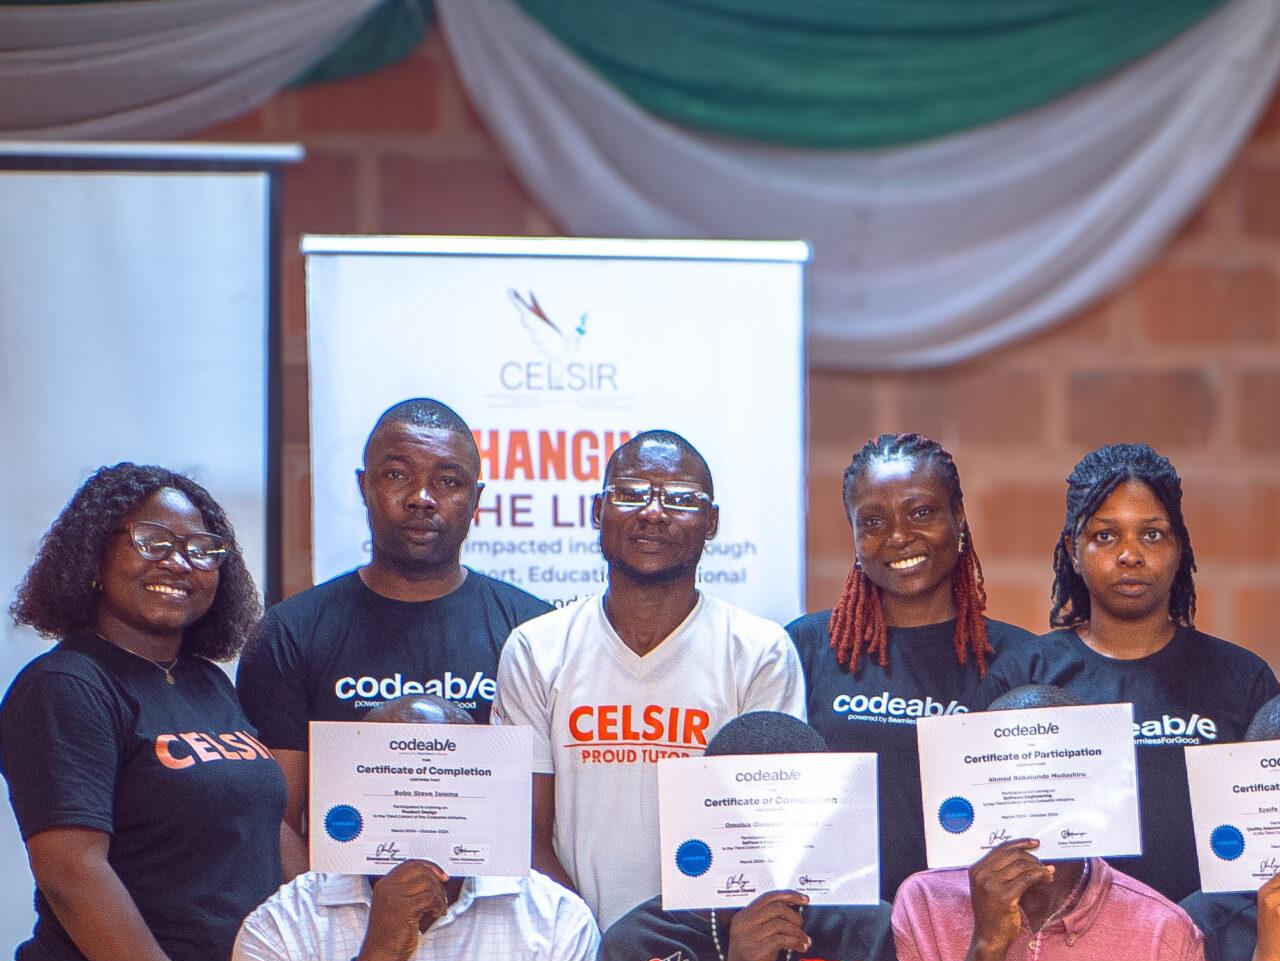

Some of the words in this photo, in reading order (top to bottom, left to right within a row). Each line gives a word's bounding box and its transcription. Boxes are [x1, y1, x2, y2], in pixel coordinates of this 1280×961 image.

[500, 361, 617, 391] CELSIR
[473, 429, 642, 481] HANGI
[475, 493, 534, 528] HE
[465, 538, 562, 557] impacted
[703, 539, 757, 559] ough
[528, 566, 606, 583] Educati
[698, 566, 747, 583] ional
[569, 704, 710, 745] CELSIR
[848, 714, 878, 722] powered
[878, 716, 888, 724] by
[888, 716, 917, 725] Seamles
[582, 749, 637, 764] PROUD
[964, 752, 1020, 764] Certificate
[1021, 751, 1033, 760] of
[1034, 747, 1102, 759] Participation
[356, 764, 414, 775] Certificate
[415, 766, 427, 775] of
[428, 766, 492, 778] Completion
[704, 796, 760, 808] Certificate
[762, 796, 773, 805] of
